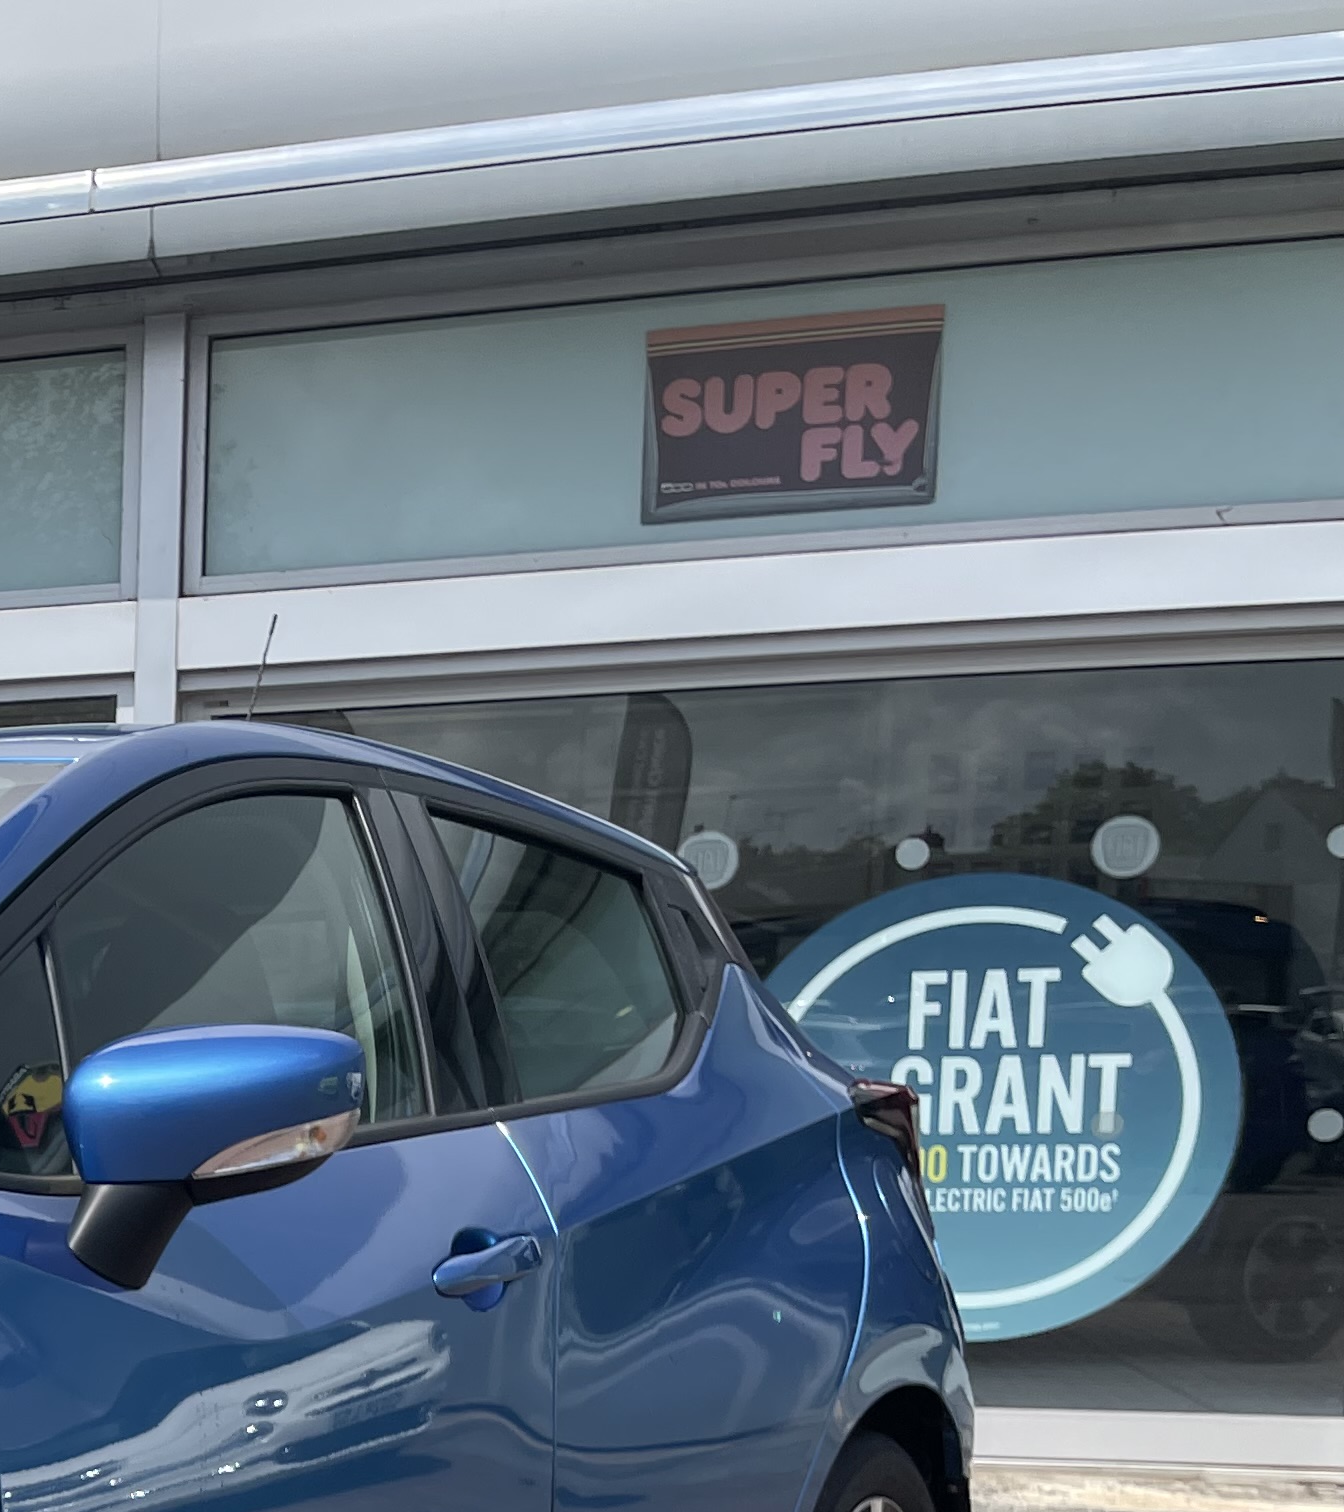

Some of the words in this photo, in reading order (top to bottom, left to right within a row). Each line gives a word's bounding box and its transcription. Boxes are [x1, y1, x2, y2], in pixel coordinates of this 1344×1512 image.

[660, 362, 893, 438] SUPER
[799, 419, 920, 483] FLY
[907, 966, 1063, 1051] FIAT
[890, 1052, 1133, 1135] GRANT
[956, 1142, 1121, 1184] TOWARDS
[1012, 1187, 1055, 1213] FIAT
